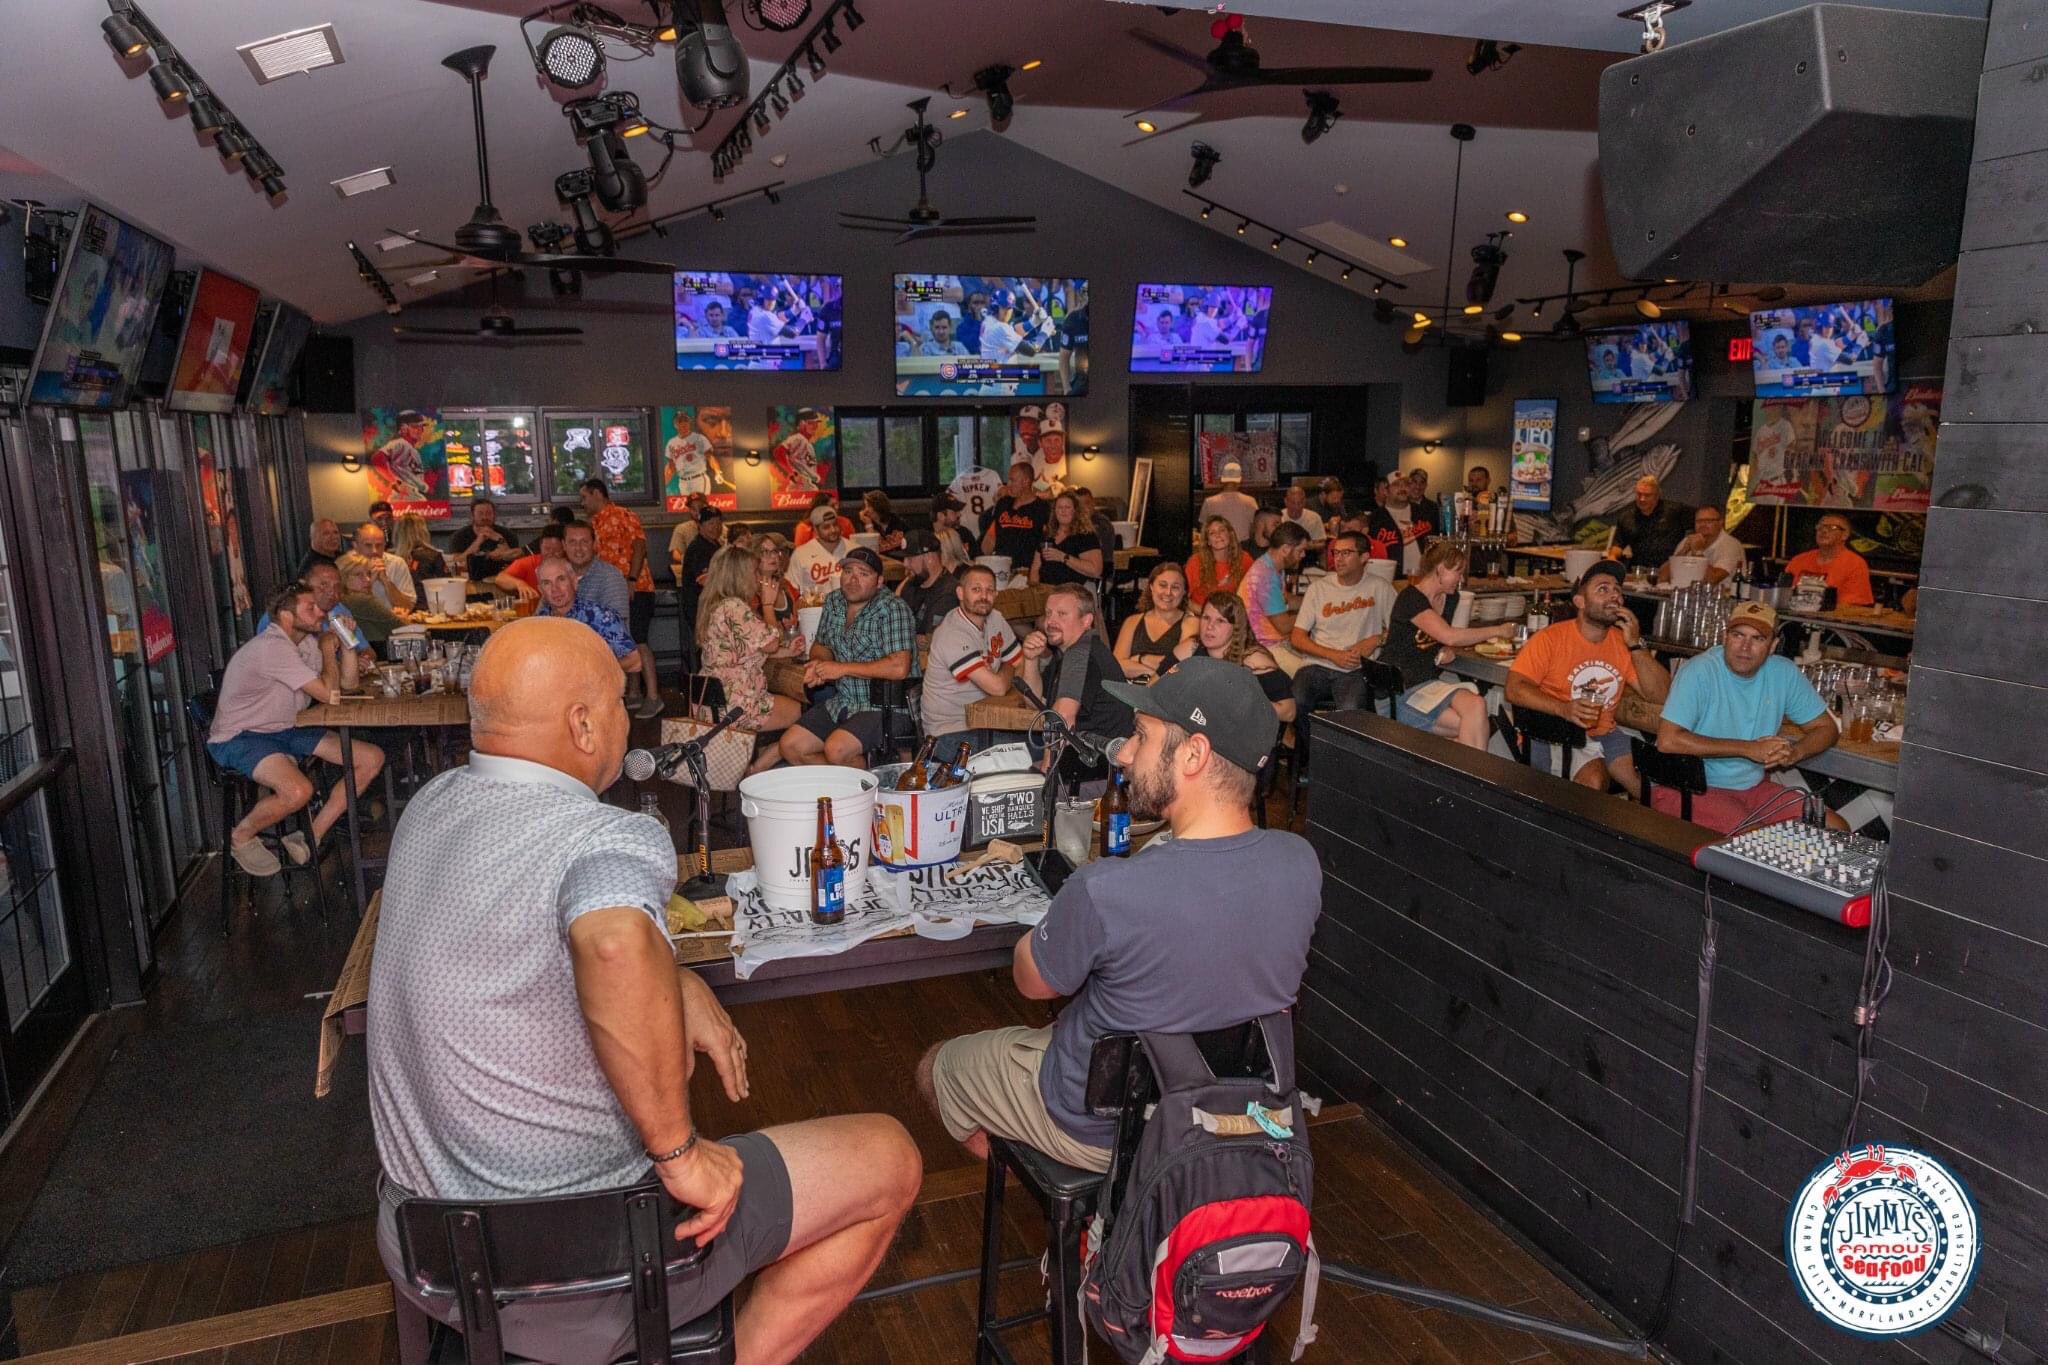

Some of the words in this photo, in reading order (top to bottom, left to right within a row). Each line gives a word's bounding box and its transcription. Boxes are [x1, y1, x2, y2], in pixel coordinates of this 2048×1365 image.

[1728, 338, 1752, 361] EXIT
[1902, 452, 1923, 473] CAL
[391, 503, 448, 517] udweiser
[970, 495, 985, 515] 8
[1567, 660, 1624, 681] BALTIMORE
[1006, 791, 1035, 806] TWO
[981, 807, 990, 815] WE
[991, 804, 1006, 813] SHIP
[1007, 810, 1035, 820] HALLS
[981, 818, 1006, 836] USA
